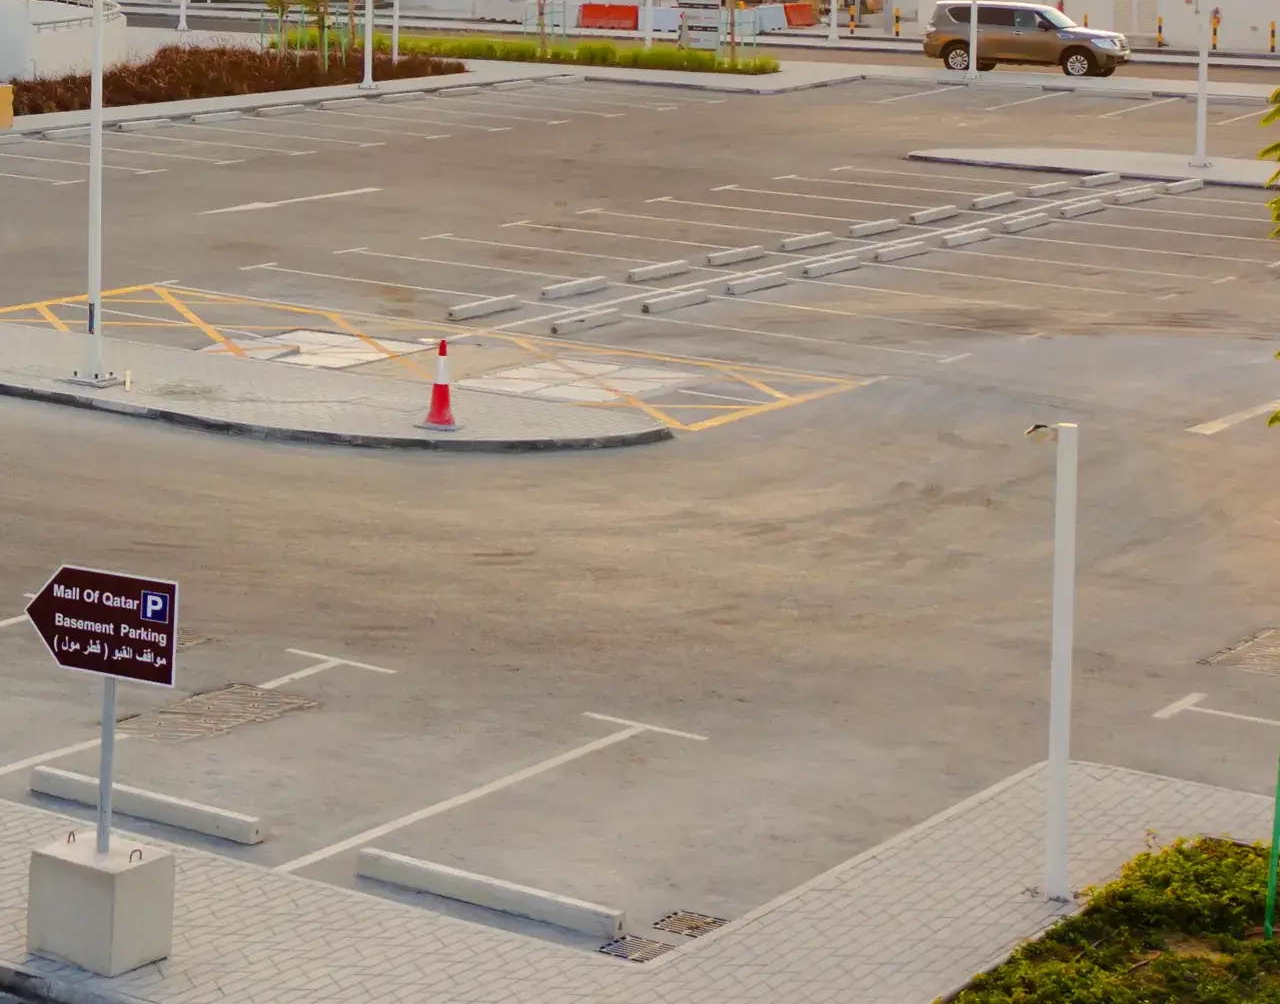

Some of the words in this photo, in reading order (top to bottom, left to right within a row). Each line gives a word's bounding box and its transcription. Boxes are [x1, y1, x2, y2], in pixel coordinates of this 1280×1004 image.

[53, 583, 80, 600] Mall
[83, 589, 100, 603] Of
[102, 592, 139, 611] Qatar
[146, 595, 163, 618] P
[55, 612, 114, 635] Basement
[120, 624, 167, 647] Parking
[112, 645, 133, 661] القبو
[135, 648, 167, 668] مواقف
